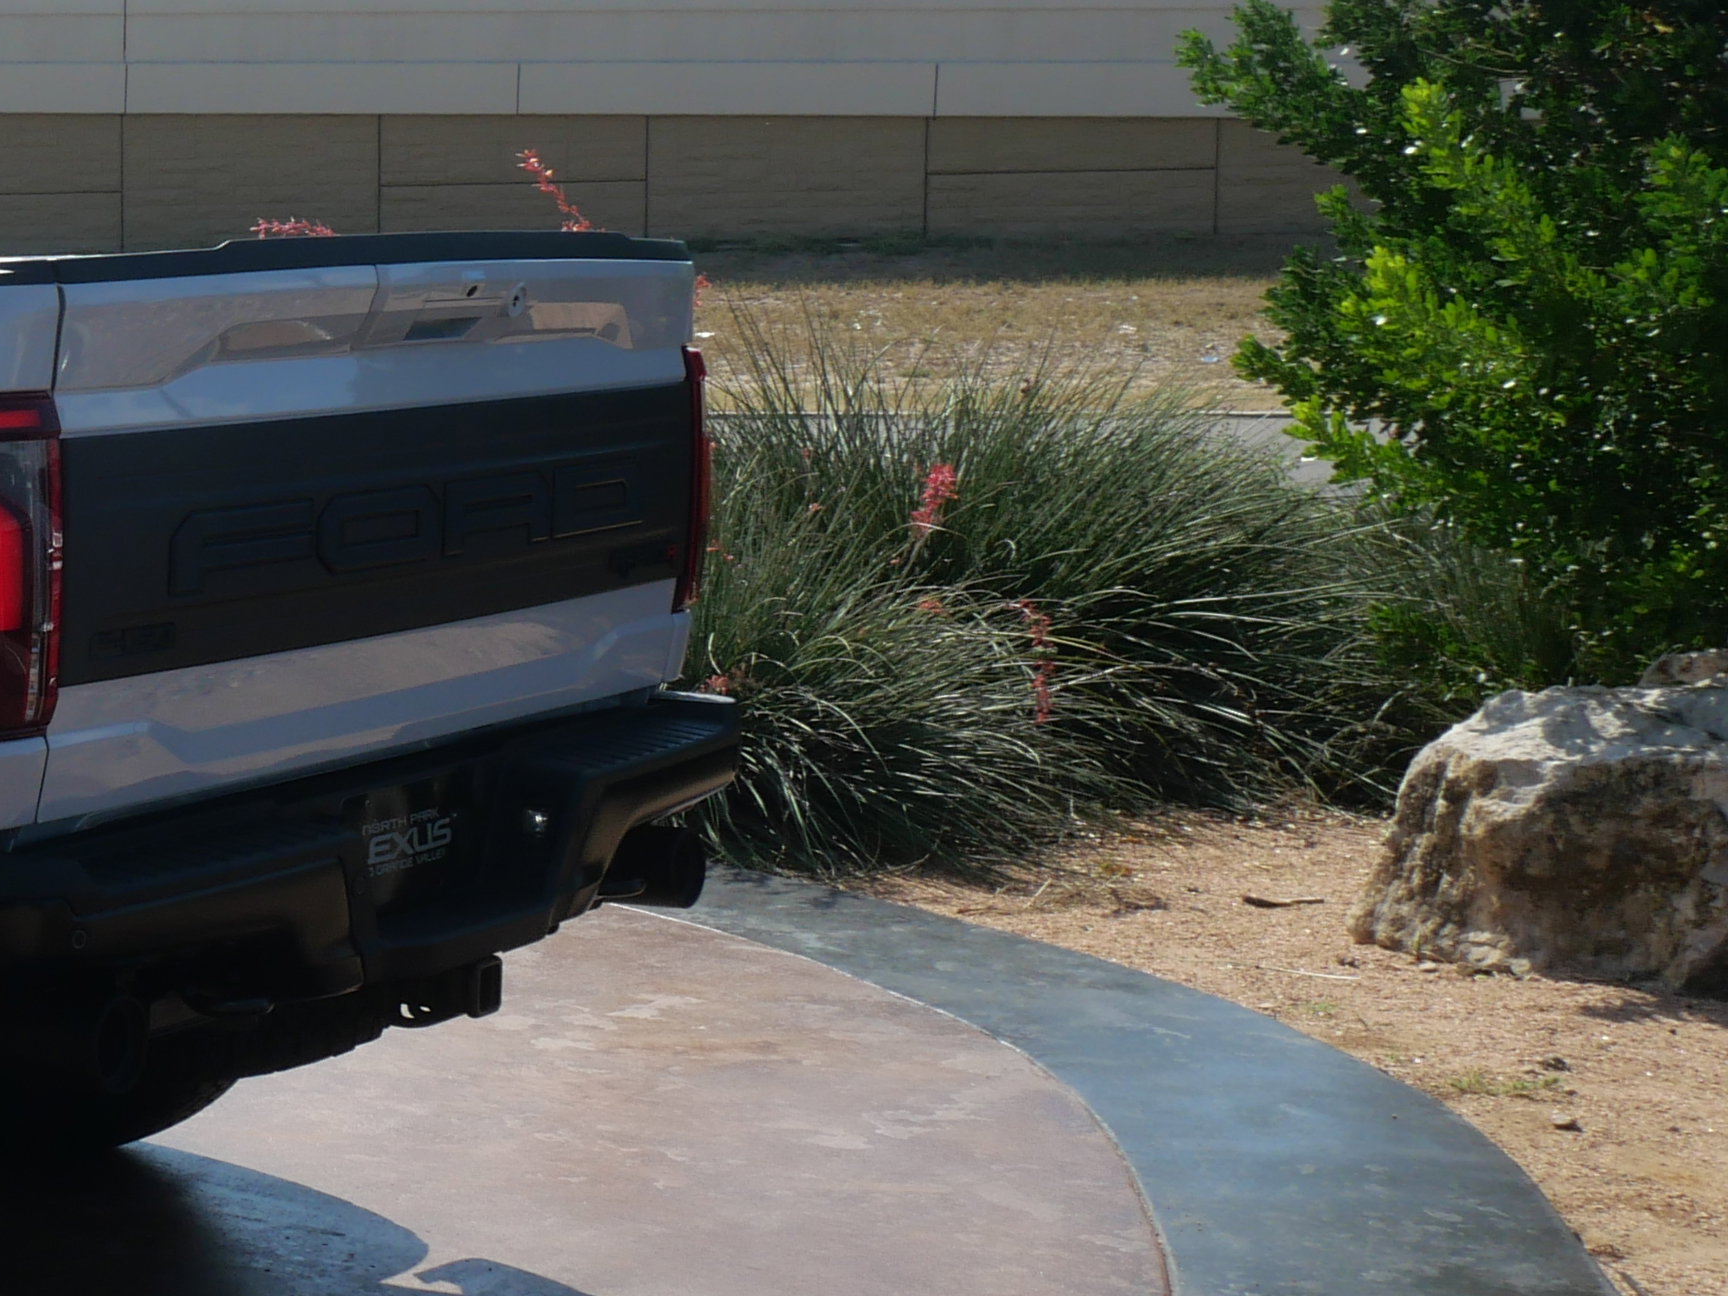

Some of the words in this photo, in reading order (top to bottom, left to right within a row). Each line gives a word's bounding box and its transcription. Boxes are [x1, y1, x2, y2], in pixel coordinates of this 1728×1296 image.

[167, 456, 645, 598] FORD
[362, 815, 408, 836] NORTH
[367, 817, 452, 865] EXUS
